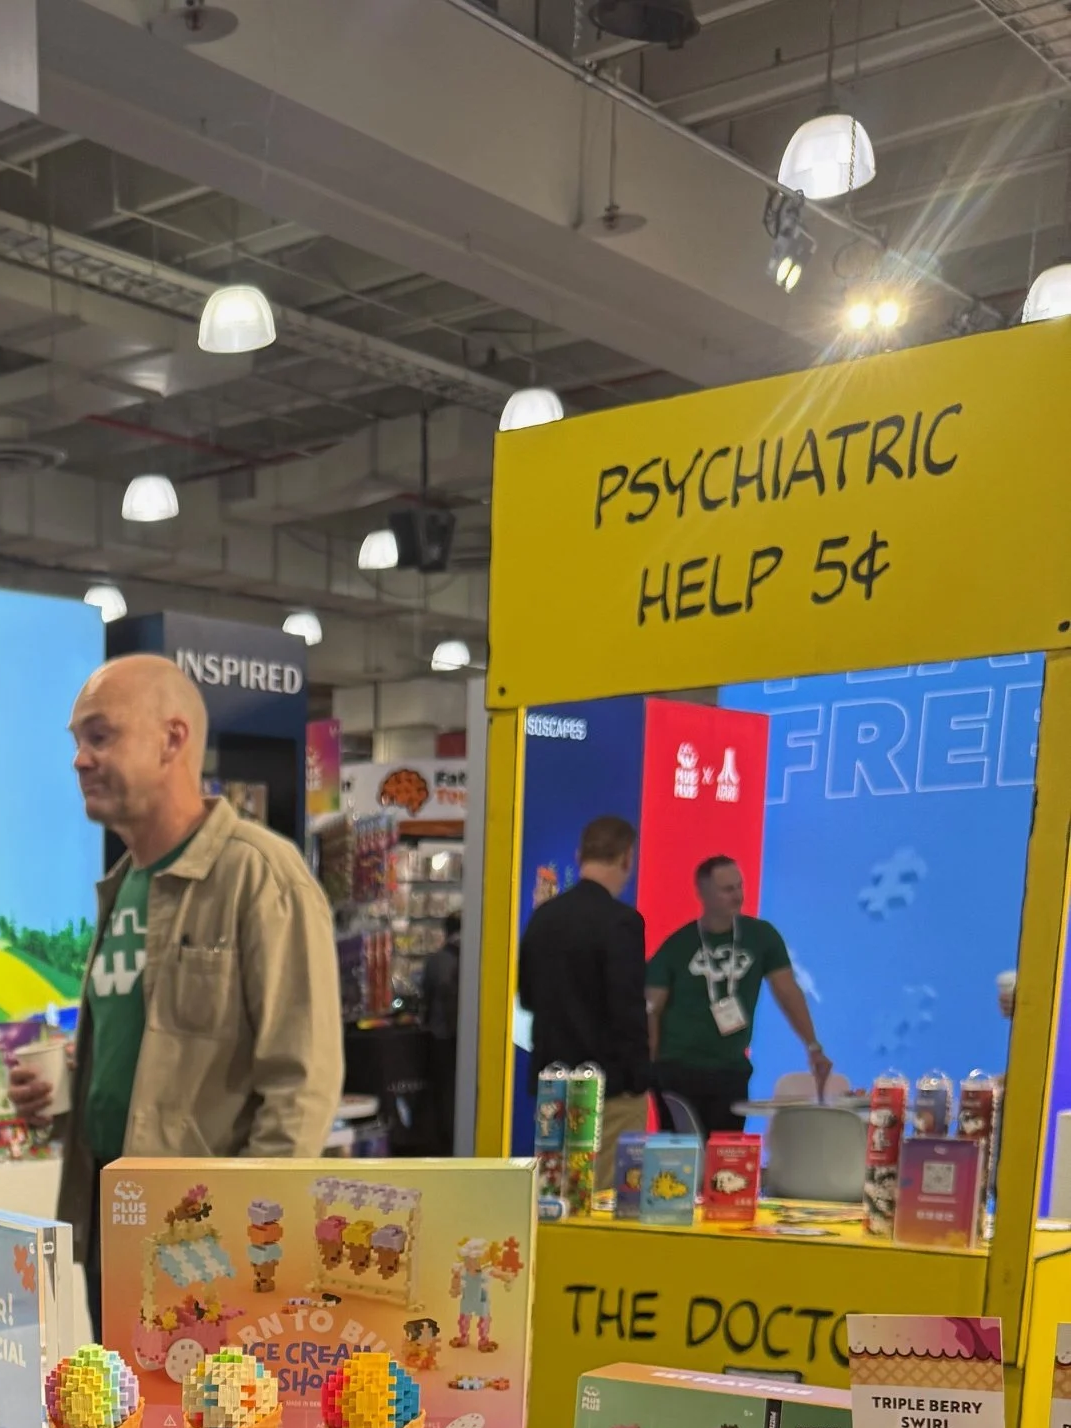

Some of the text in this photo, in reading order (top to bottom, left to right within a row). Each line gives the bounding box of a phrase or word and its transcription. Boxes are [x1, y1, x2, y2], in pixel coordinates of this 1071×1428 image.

[593, 402, 963, 530] PSYCHIATRIC
[637, 529, 891, 627] HELP 5¢
[175, 648, 303, 695] INSPIRED
[112, 1202, 147, 1214] PLUS
[112, 1214, 147, 1226] PLUS
[291, 1308, 334, 1333] TO
[564, 1284, 660, 1341] THE
[871, 1396, 983, 1416] TRIPLE BERRY
